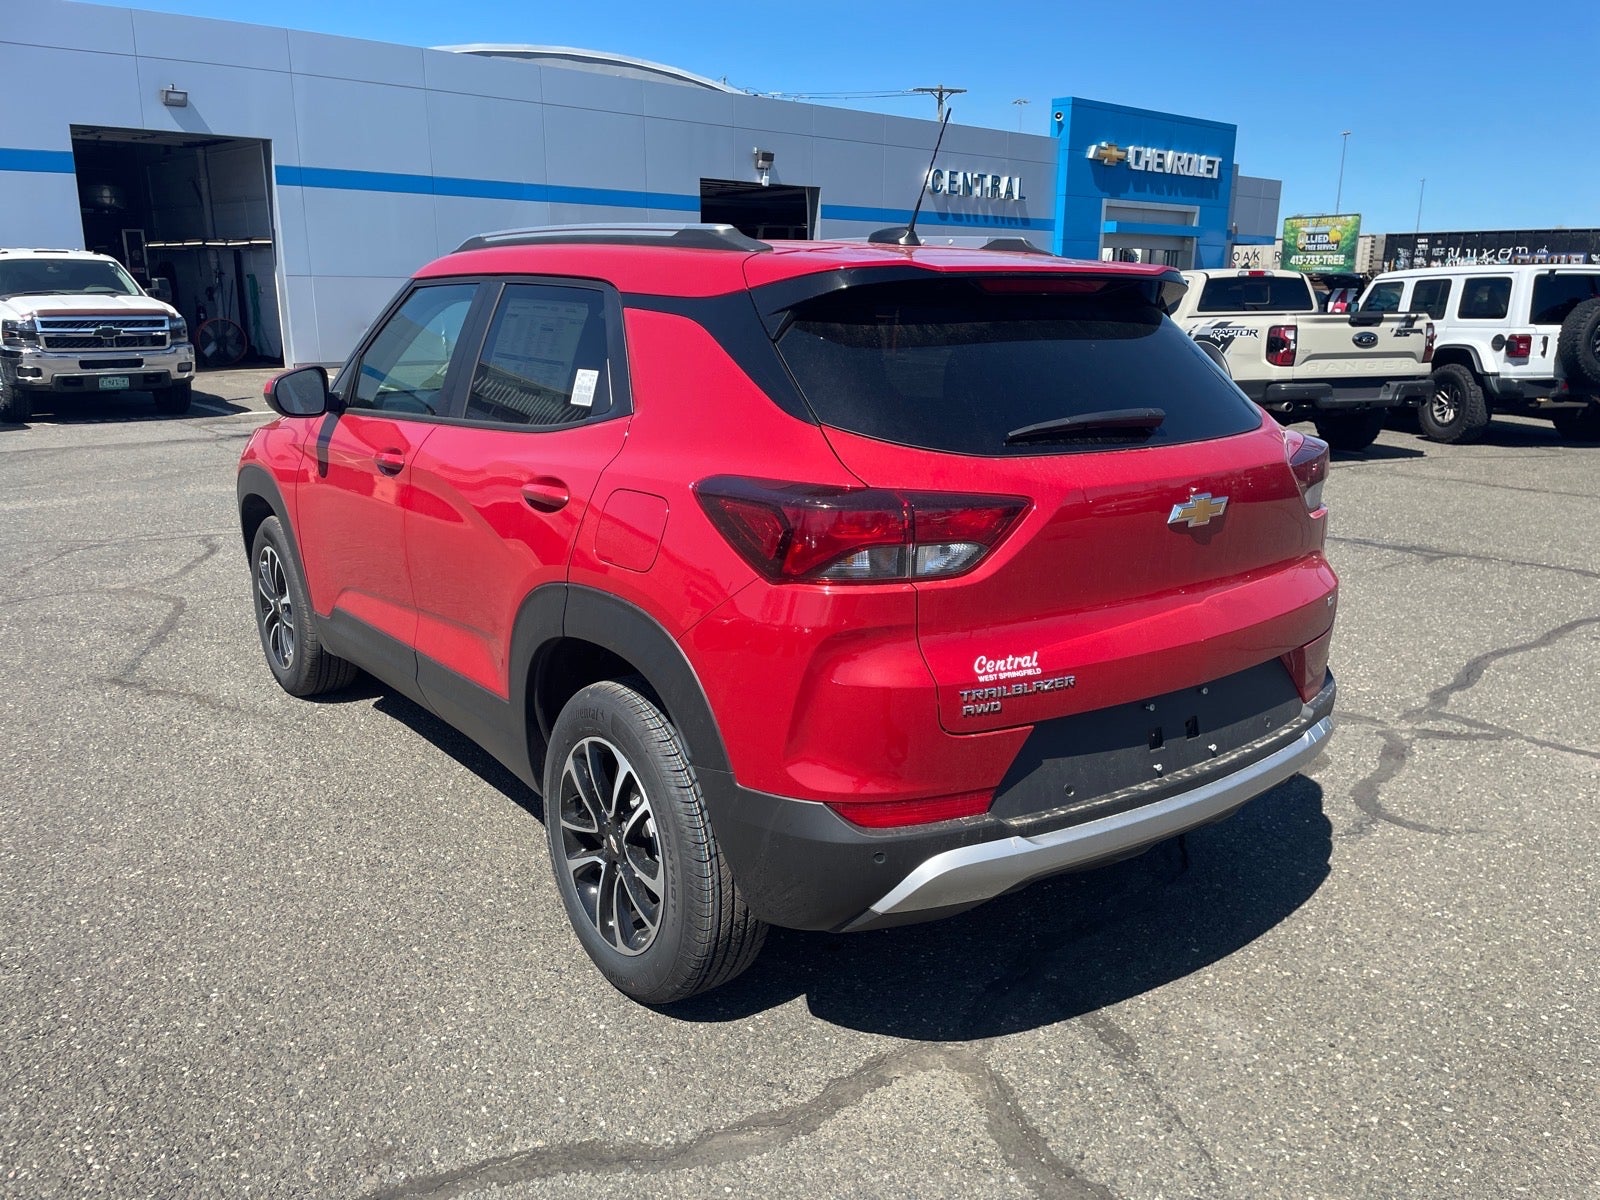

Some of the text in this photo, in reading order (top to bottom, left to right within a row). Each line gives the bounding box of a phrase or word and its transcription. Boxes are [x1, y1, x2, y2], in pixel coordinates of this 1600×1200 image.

[1127, 145, 1222, 179] CHEVROLET
[930, 168, 1026, 200] CENTRAL
[1233, 251, 1260, 261] OAK
[1290, 254, 1346, 265] 413-733-TREE
[1210, 328, 1259, 341] RAPTOR
[1306, 360, 1415, 373] RANGER
[973, 651, 1039, 674] Central
[978, 667, 1042, 683] WEST SPRINGFIELD
[959, 675, 1077, 703] TRAILBLAZER
[962, 701, 1002, 717] AWD
